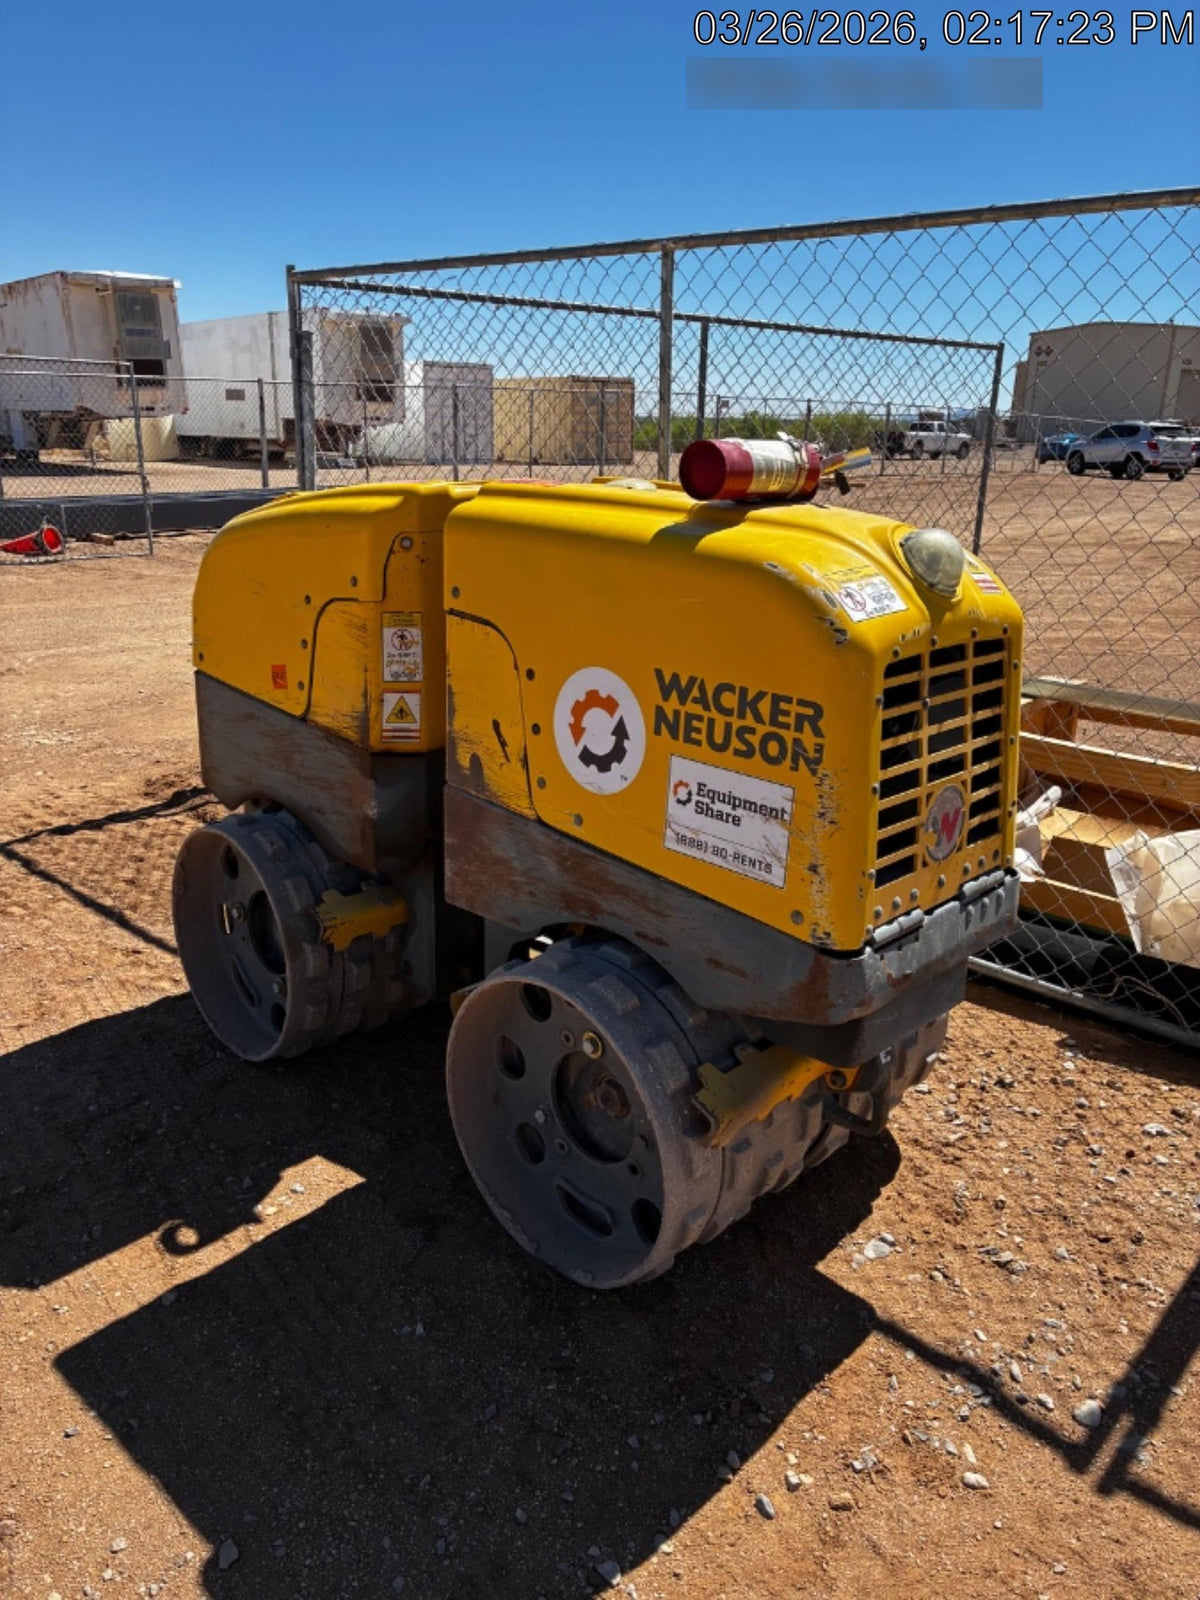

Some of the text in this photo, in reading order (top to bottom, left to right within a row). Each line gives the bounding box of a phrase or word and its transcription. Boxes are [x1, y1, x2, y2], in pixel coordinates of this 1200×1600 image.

[654, 668, 826, 738] WACKER
[653, 705, 825, 777] NEUSON
[694, 800, 742, 827] Share
[696, 782, 789, 822] Equipment
